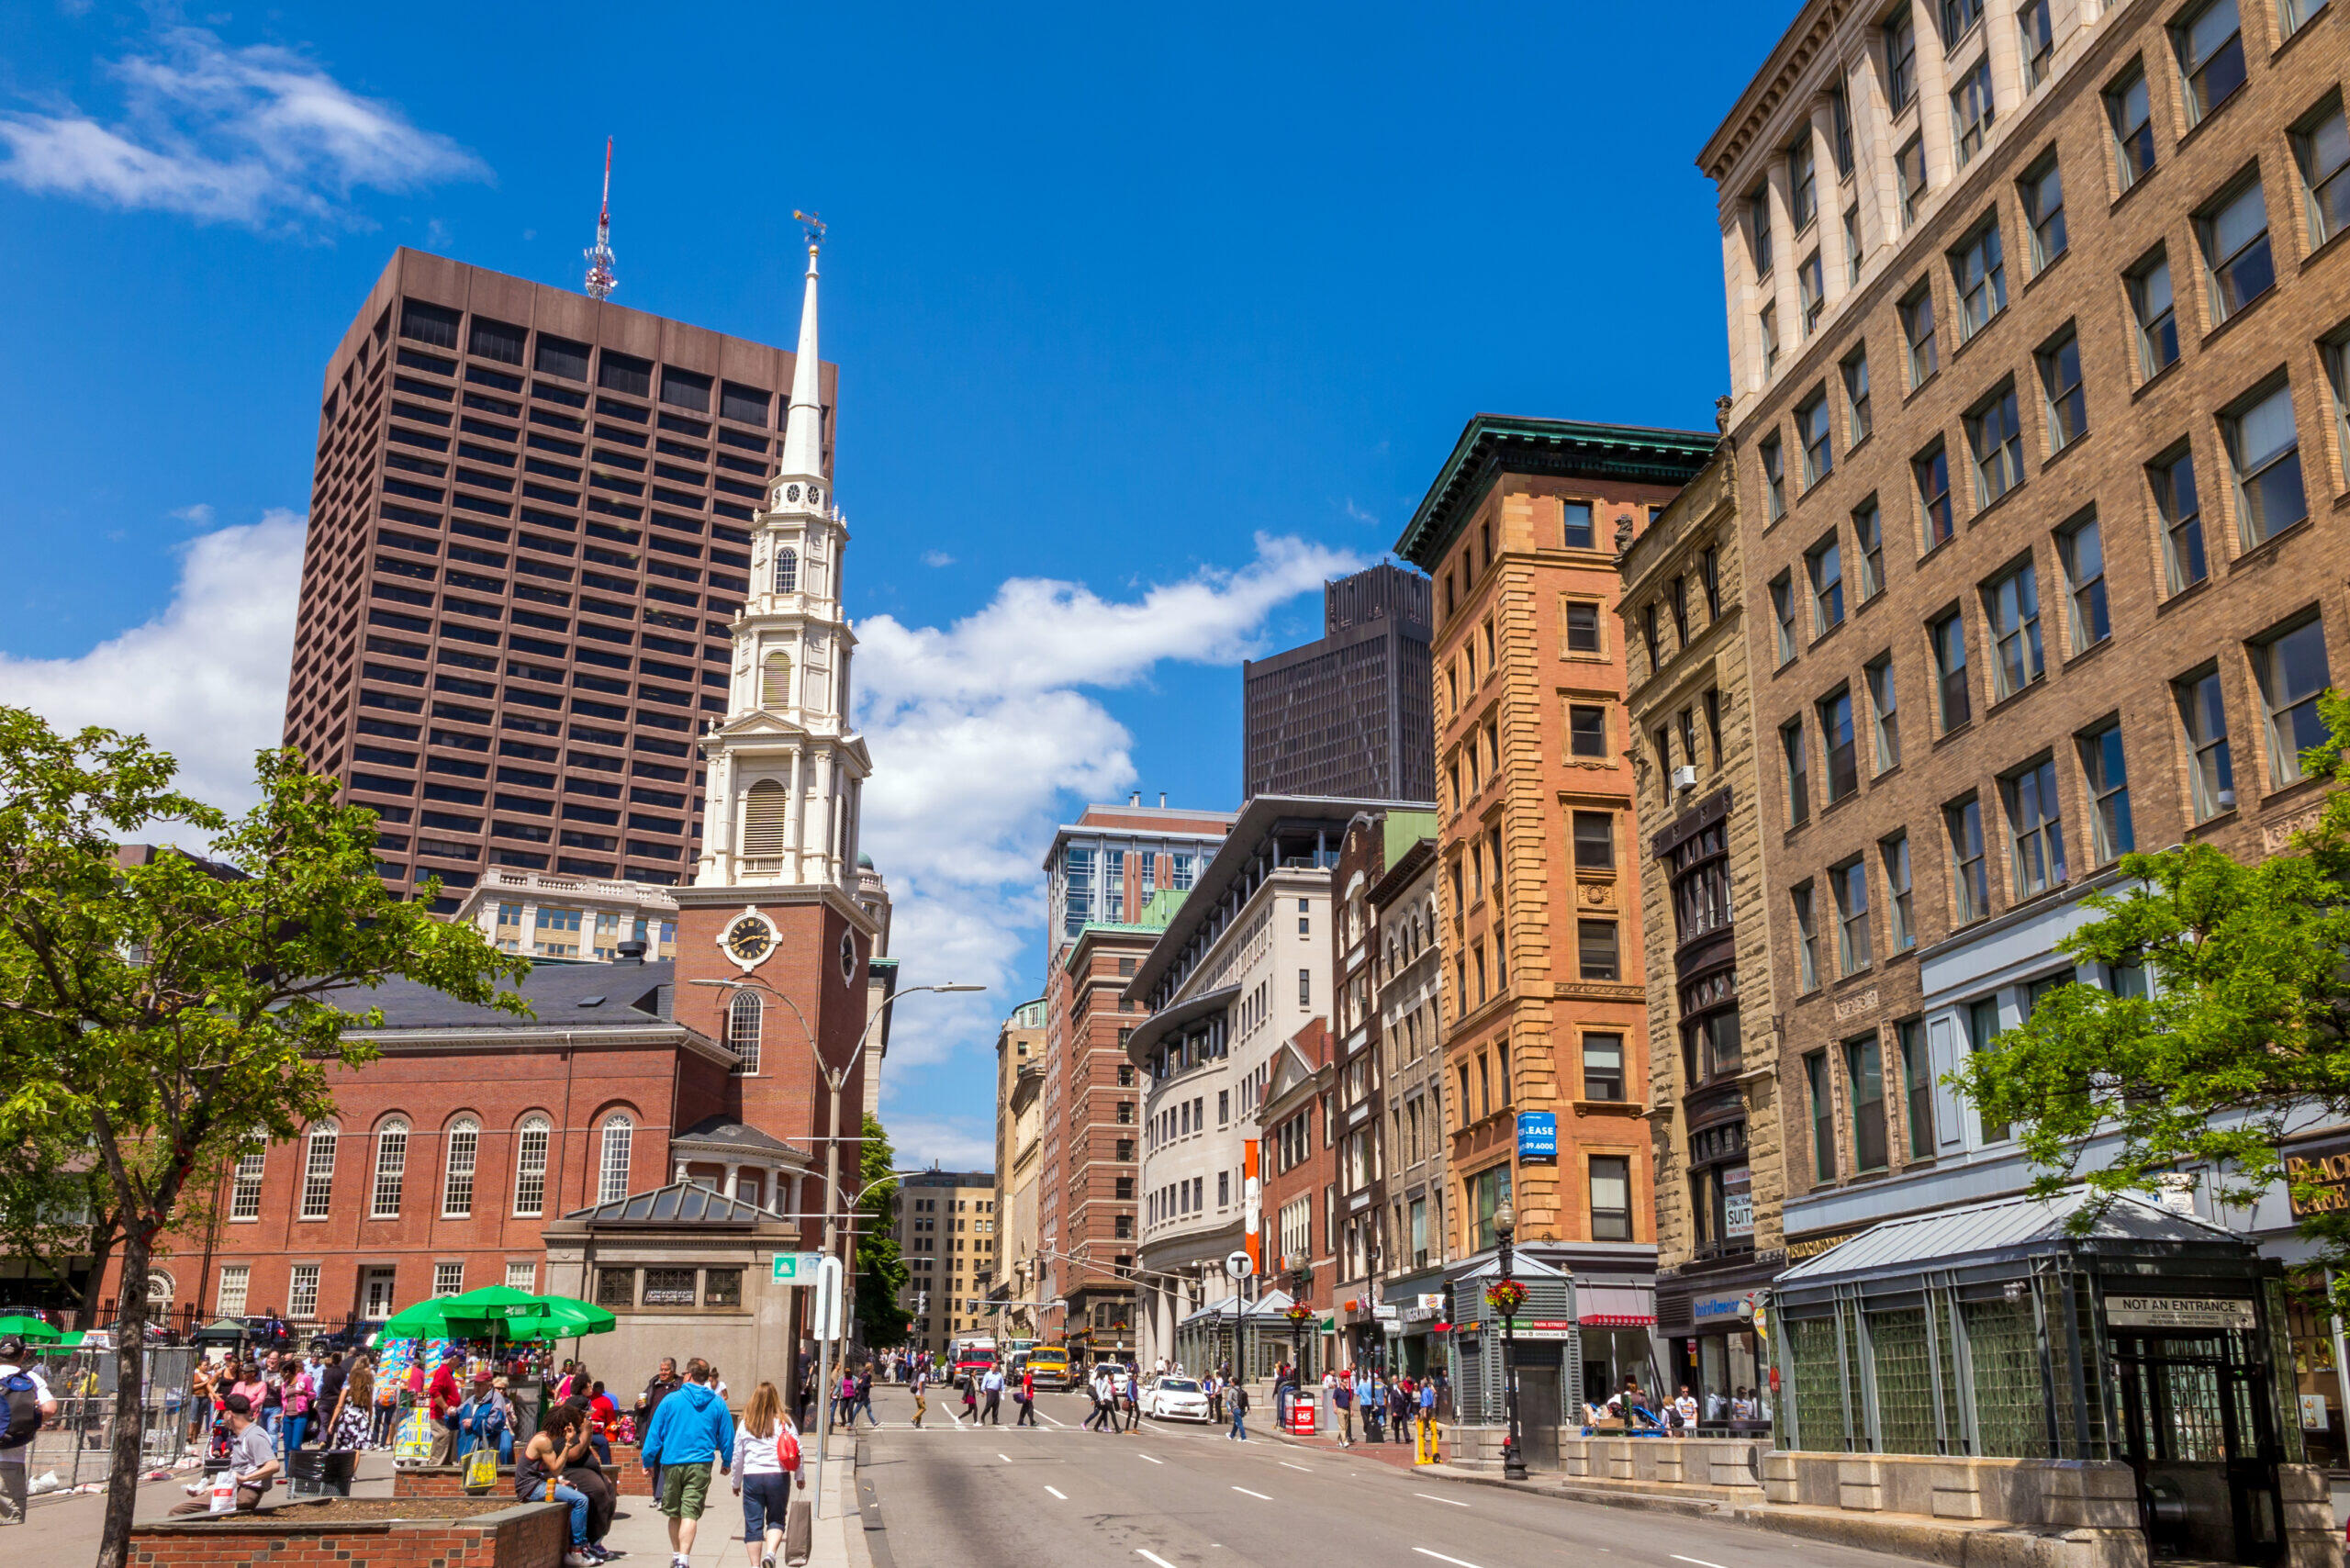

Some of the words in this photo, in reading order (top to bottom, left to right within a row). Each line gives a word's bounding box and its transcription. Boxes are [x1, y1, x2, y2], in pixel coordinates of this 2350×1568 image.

[2287, 1153, 2350, 1185] BLAC
[1728, 1208, 1752, 1225] SUIT
[1231, 1257, 1248, 1273] T
[2122, 1299, 2148, 1310] NOT
[2152, 1300, 2168, 1311] AN
[2172, 1300, 2237, 1312] ENTRANCE
[1297, 1412, 1311, 1421] $45
